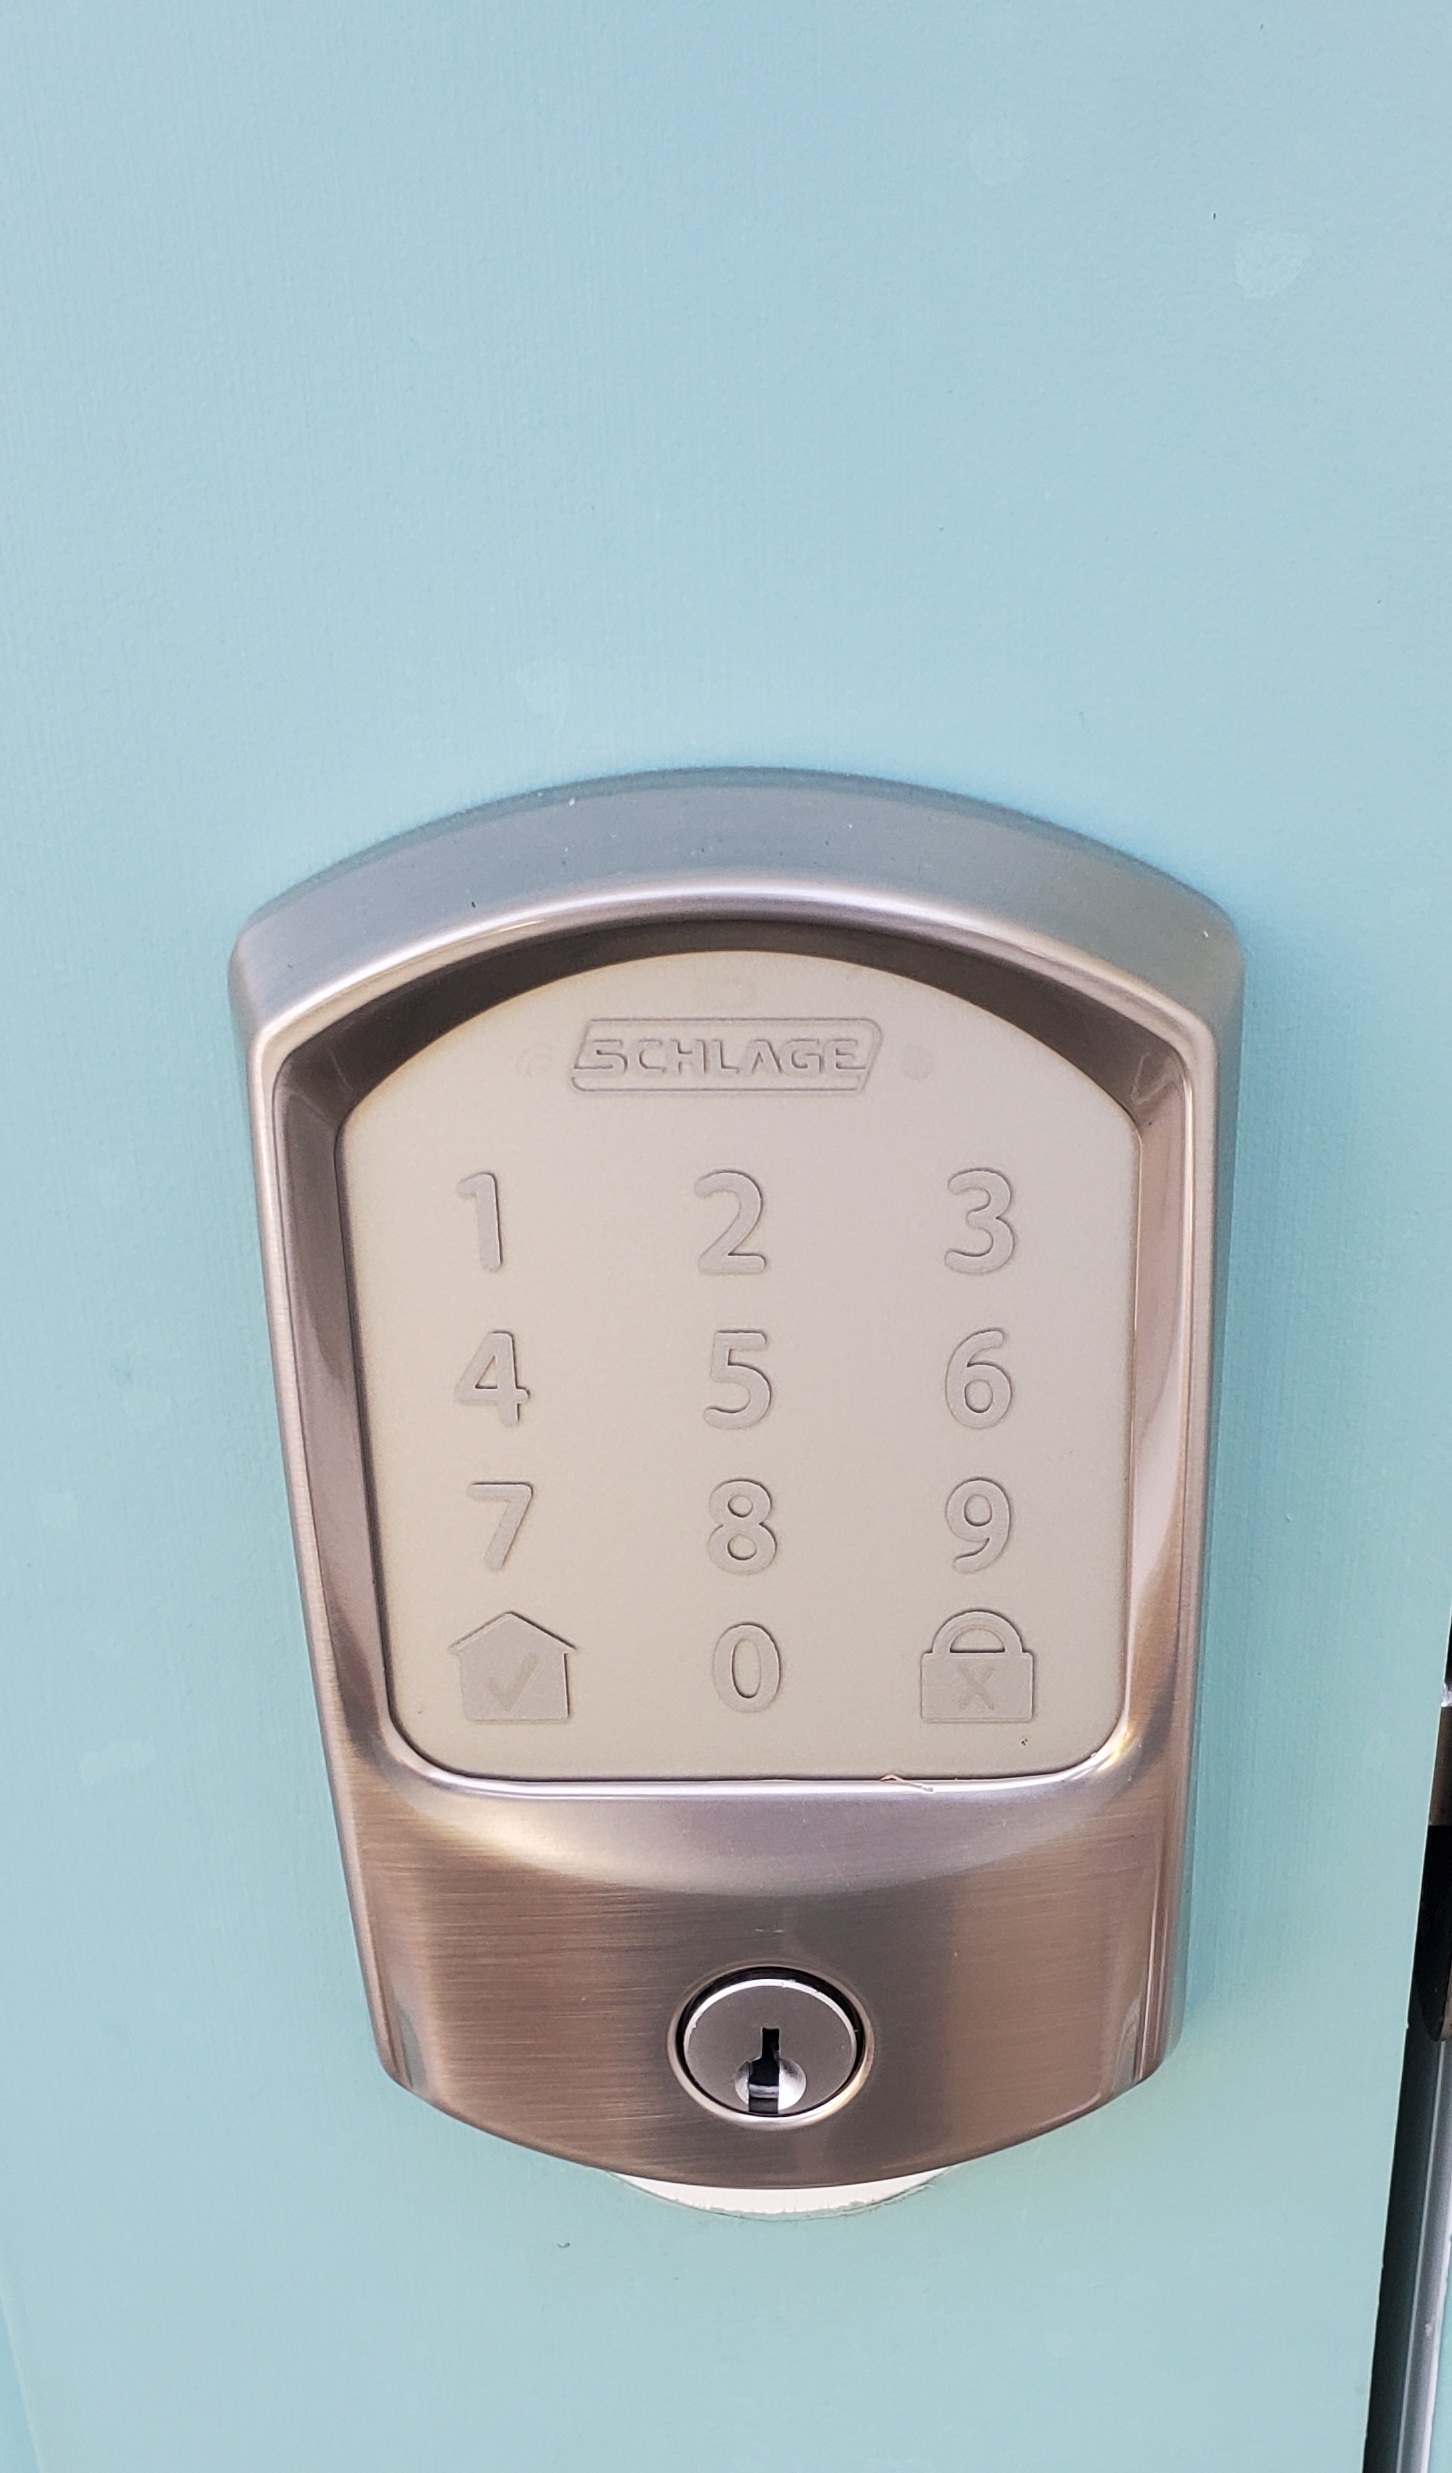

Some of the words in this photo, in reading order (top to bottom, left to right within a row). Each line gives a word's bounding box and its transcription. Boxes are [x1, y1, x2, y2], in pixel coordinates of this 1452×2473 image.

[572, 1039, 867, 1075] SCHLAGE
[456, 1171, 503, 1272] 1
[694, 1168, 769, 1276] 2
[944, 1167, 1016, 1275] 3
[454, 1329, 530, 1428] 4
[703, 1329, 772, 1430] 5
[945, 1327, 1013, 1430] 6
[467, 1481, 534, 1572] 7
[707, 1477, 778, 1576] 8
[945, 1476, 1012, 1574] 9
[712, 1622, 782, 1714] 0
